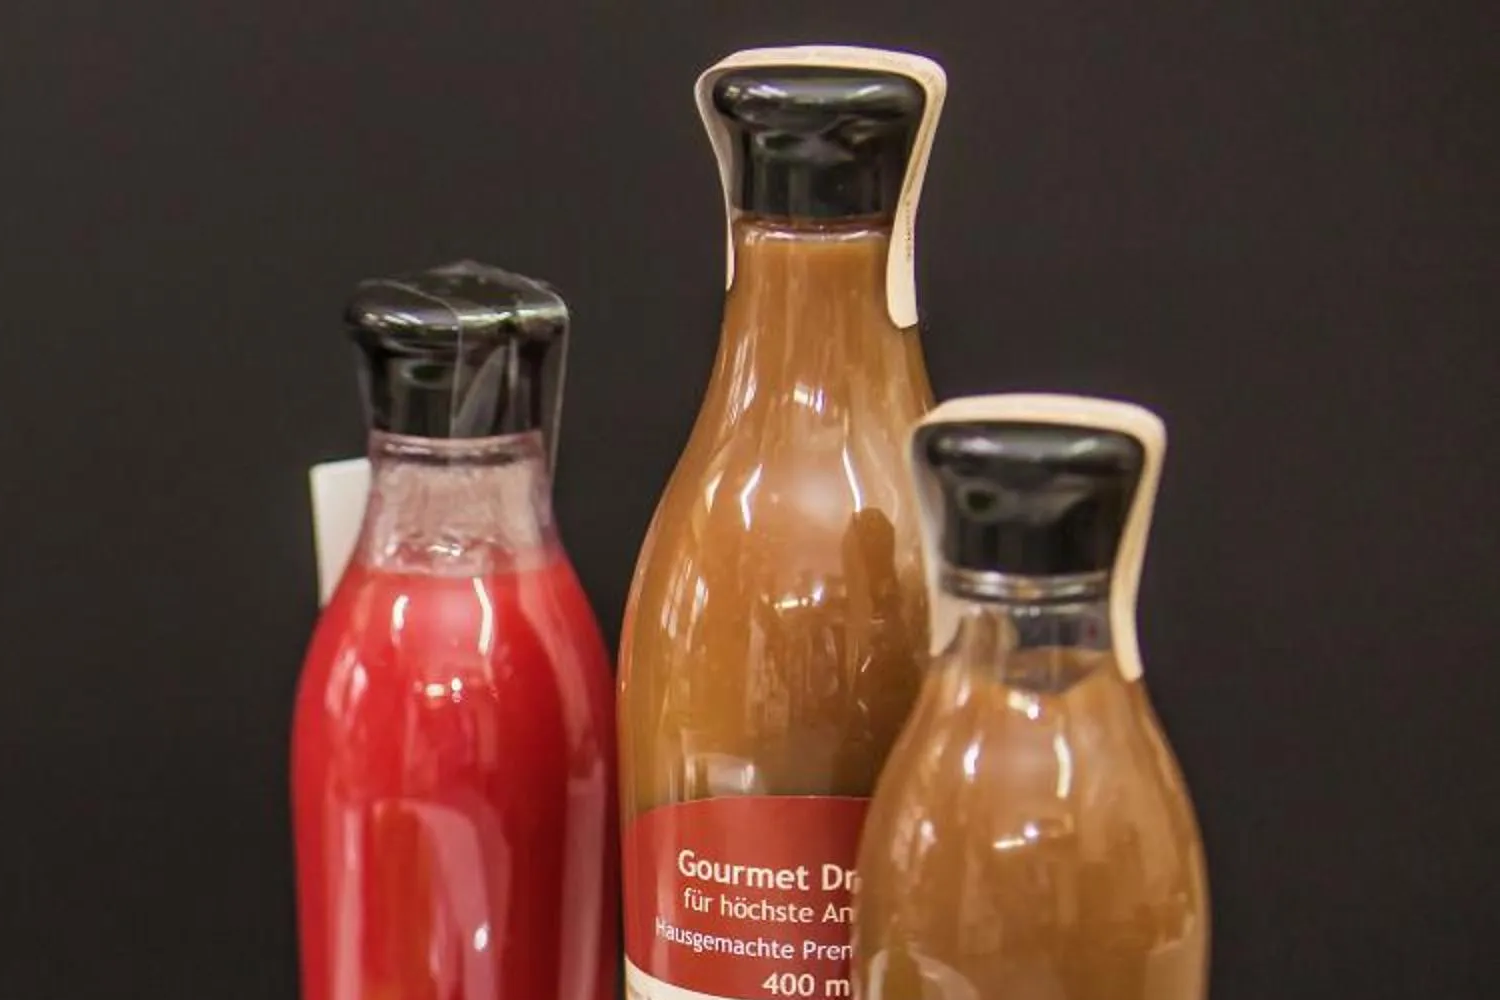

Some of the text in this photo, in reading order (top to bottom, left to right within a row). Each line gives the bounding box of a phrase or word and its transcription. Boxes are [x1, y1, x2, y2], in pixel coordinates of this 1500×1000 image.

[678, 850, 810, 890] Gourmet
[684, 888, 713, 913] für
[720, 895, 814, 923] höchste
[655, 917, 795, 960] Hausgemachte
[762, 973, 815, 997] 400
